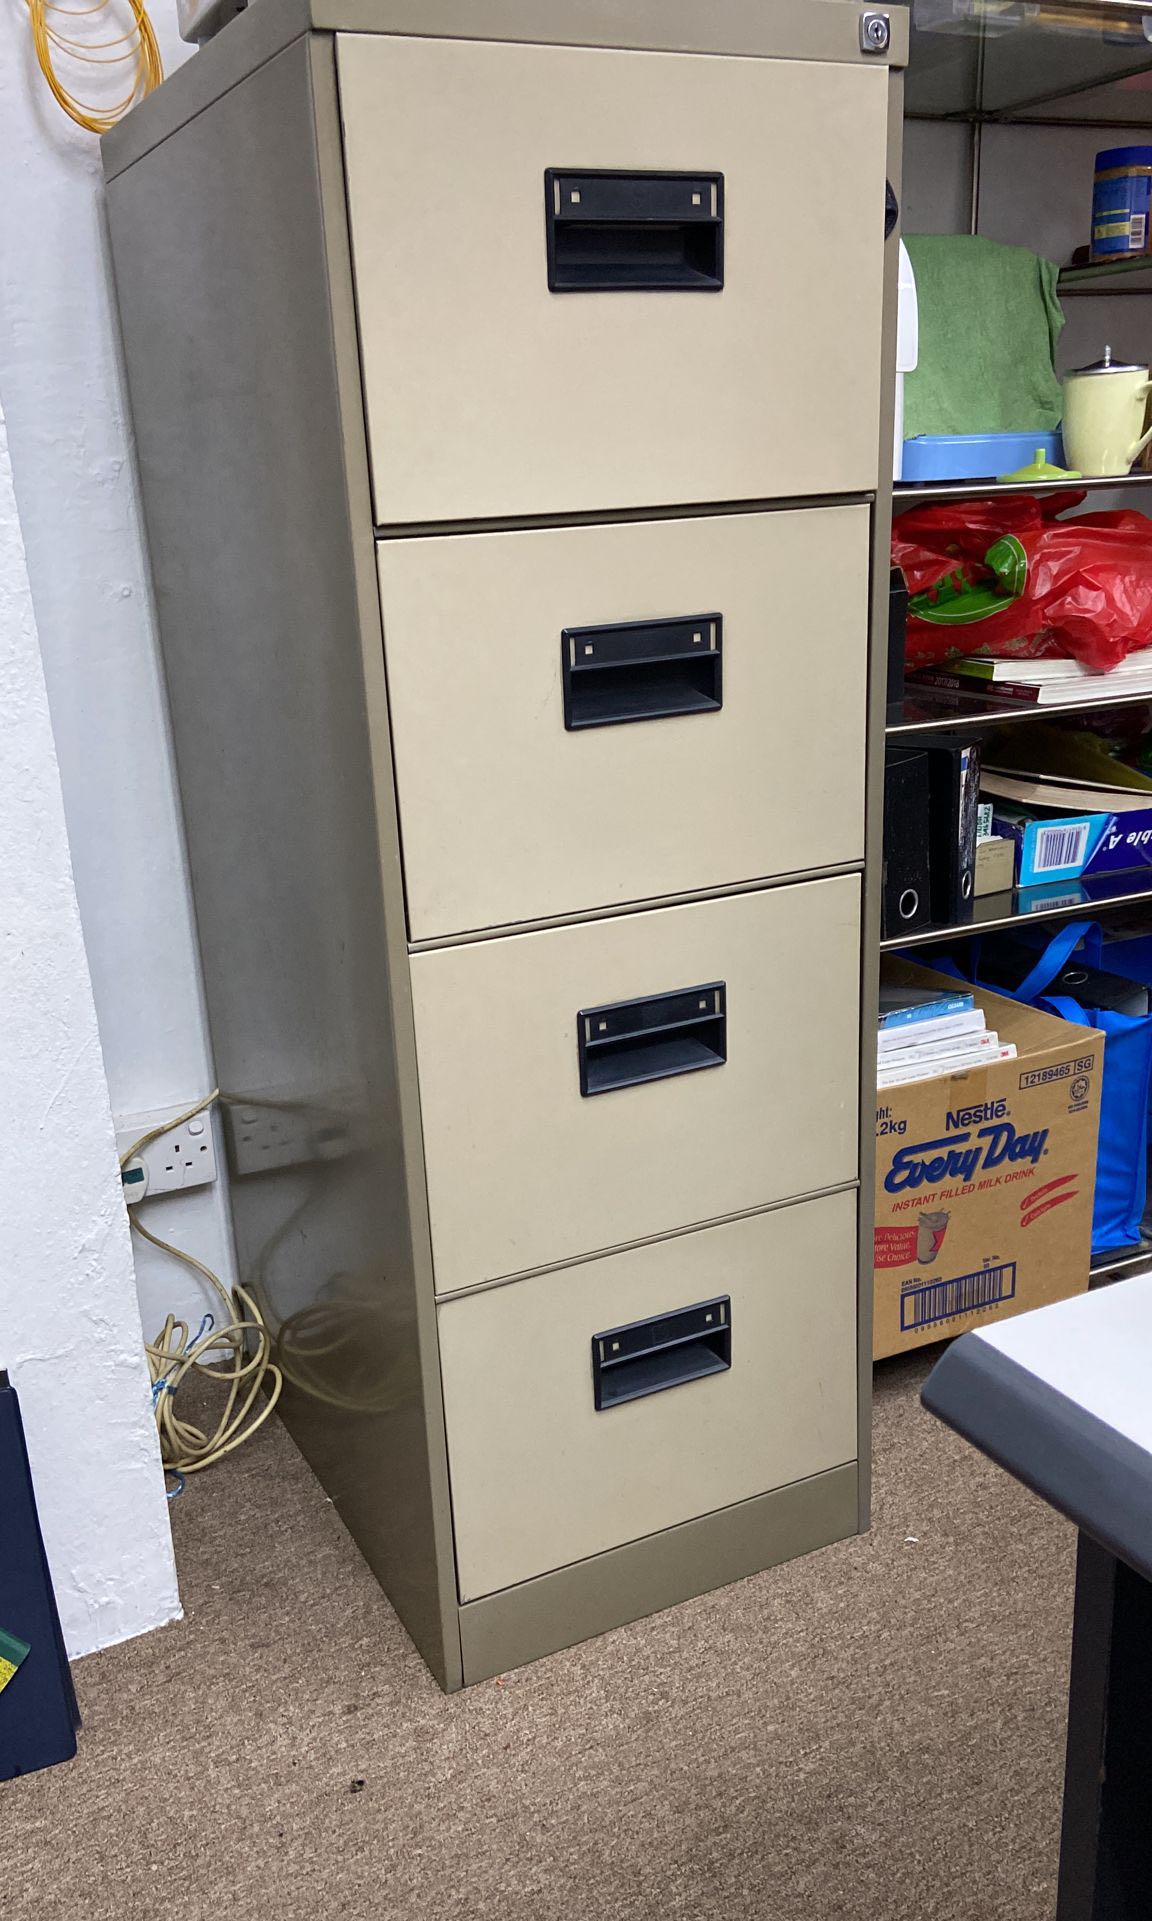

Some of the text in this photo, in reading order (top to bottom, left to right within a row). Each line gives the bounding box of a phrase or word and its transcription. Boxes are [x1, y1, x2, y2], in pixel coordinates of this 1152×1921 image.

[1108, 833, 1123, 850] A
[1024, 1058, 1092, 1086] 12189465 SG
[884, 1122, 1050, 1194] Every Day
[892, 1167, 1036, 1213] INSTANT FILLED MILK DRINK
